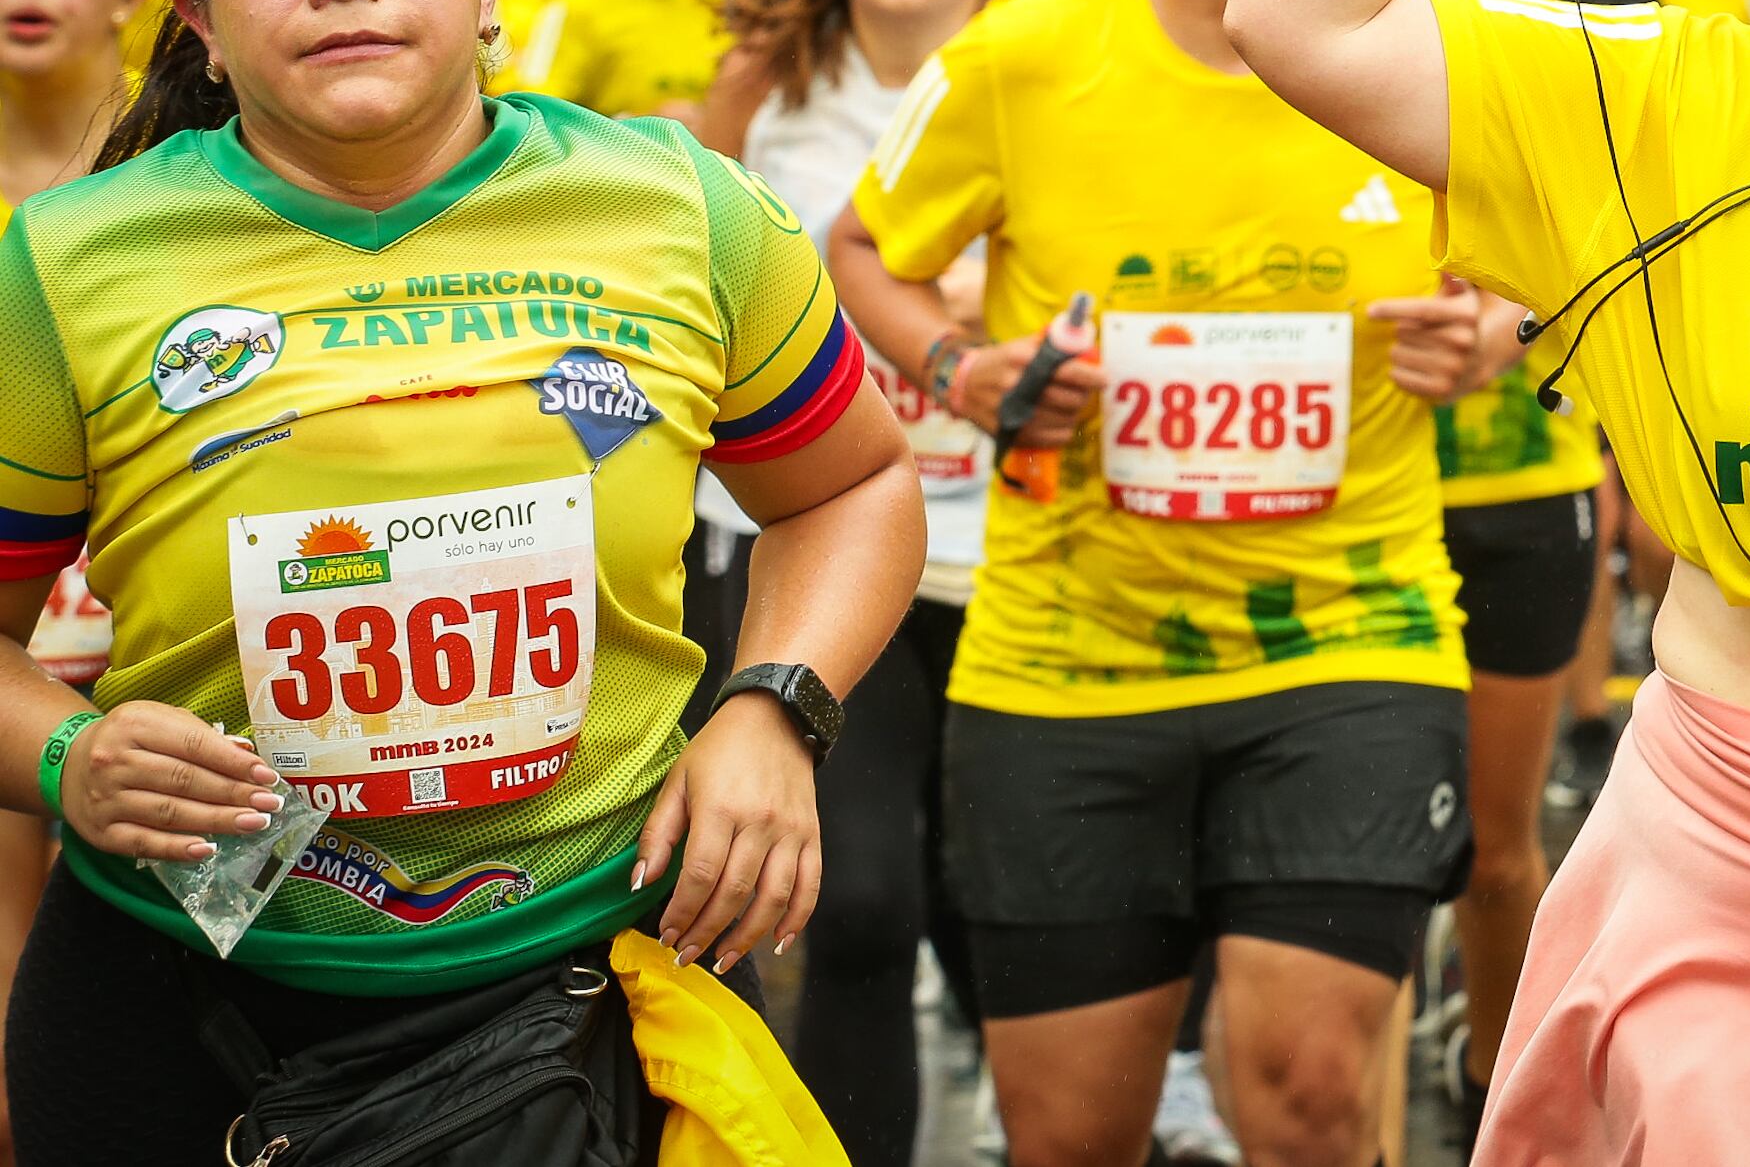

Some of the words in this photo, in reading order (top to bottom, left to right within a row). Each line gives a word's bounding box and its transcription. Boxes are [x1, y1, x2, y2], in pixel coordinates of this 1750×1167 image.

[406, 271, 604, 299] MERCADO
[558, 361, 628, 388] CLUB
[1115, 381, 1332, 450] 28285
[240, 428, 292, 452] Suavidad
[387, 501, 536, 552] porvenir
[325, 555, 364, 565] MERCADO
[445, 543, 474, 558] sólo
[479, 540, 503, 553] hay
[508, 536, 535, 548] uno
[308, 562, 383, 583] ZAPATOCA
[265, 578, 579, 721] 33675
[276, 755, 304, 764] Hilton
[369, 740, 439, 761] mmB
[443, 733, 494, 754] 2024
[491, 755, 560, 789] FILTRO
[345, 844, 390, 872] por
